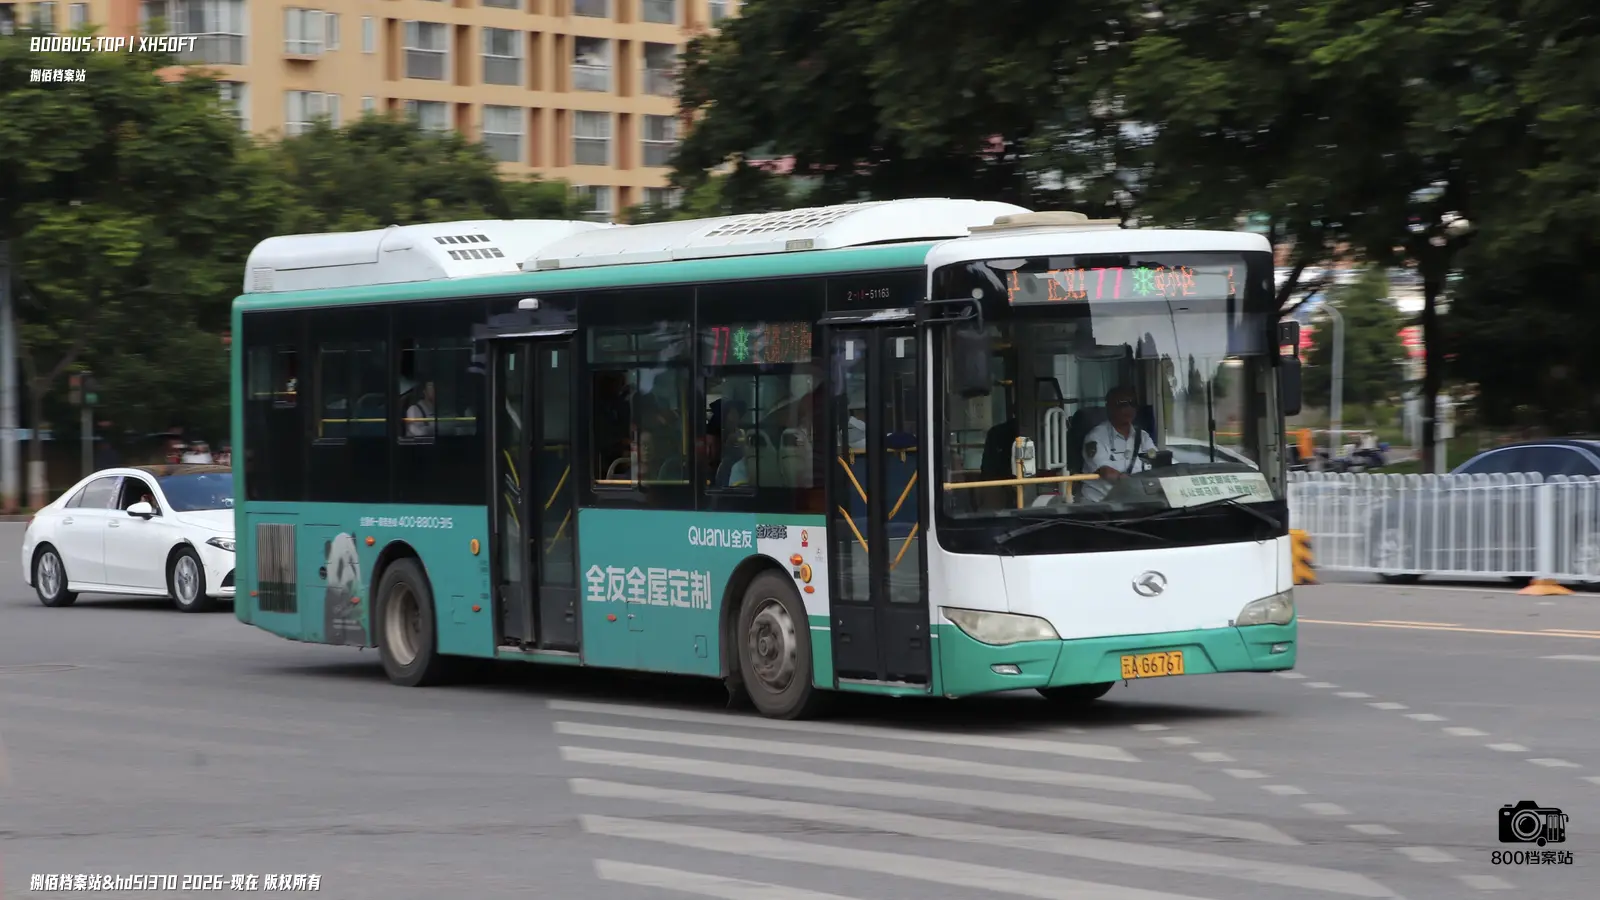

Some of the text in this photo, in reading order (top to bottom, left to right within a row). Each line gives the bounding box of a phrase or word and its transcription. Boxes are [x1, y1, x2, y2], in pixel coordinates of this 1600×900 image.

[1091, 267, 1123, 300] 77
[711, 326, 731, 365] 77
[585, 564, 712, 610] 全友全屋定制
